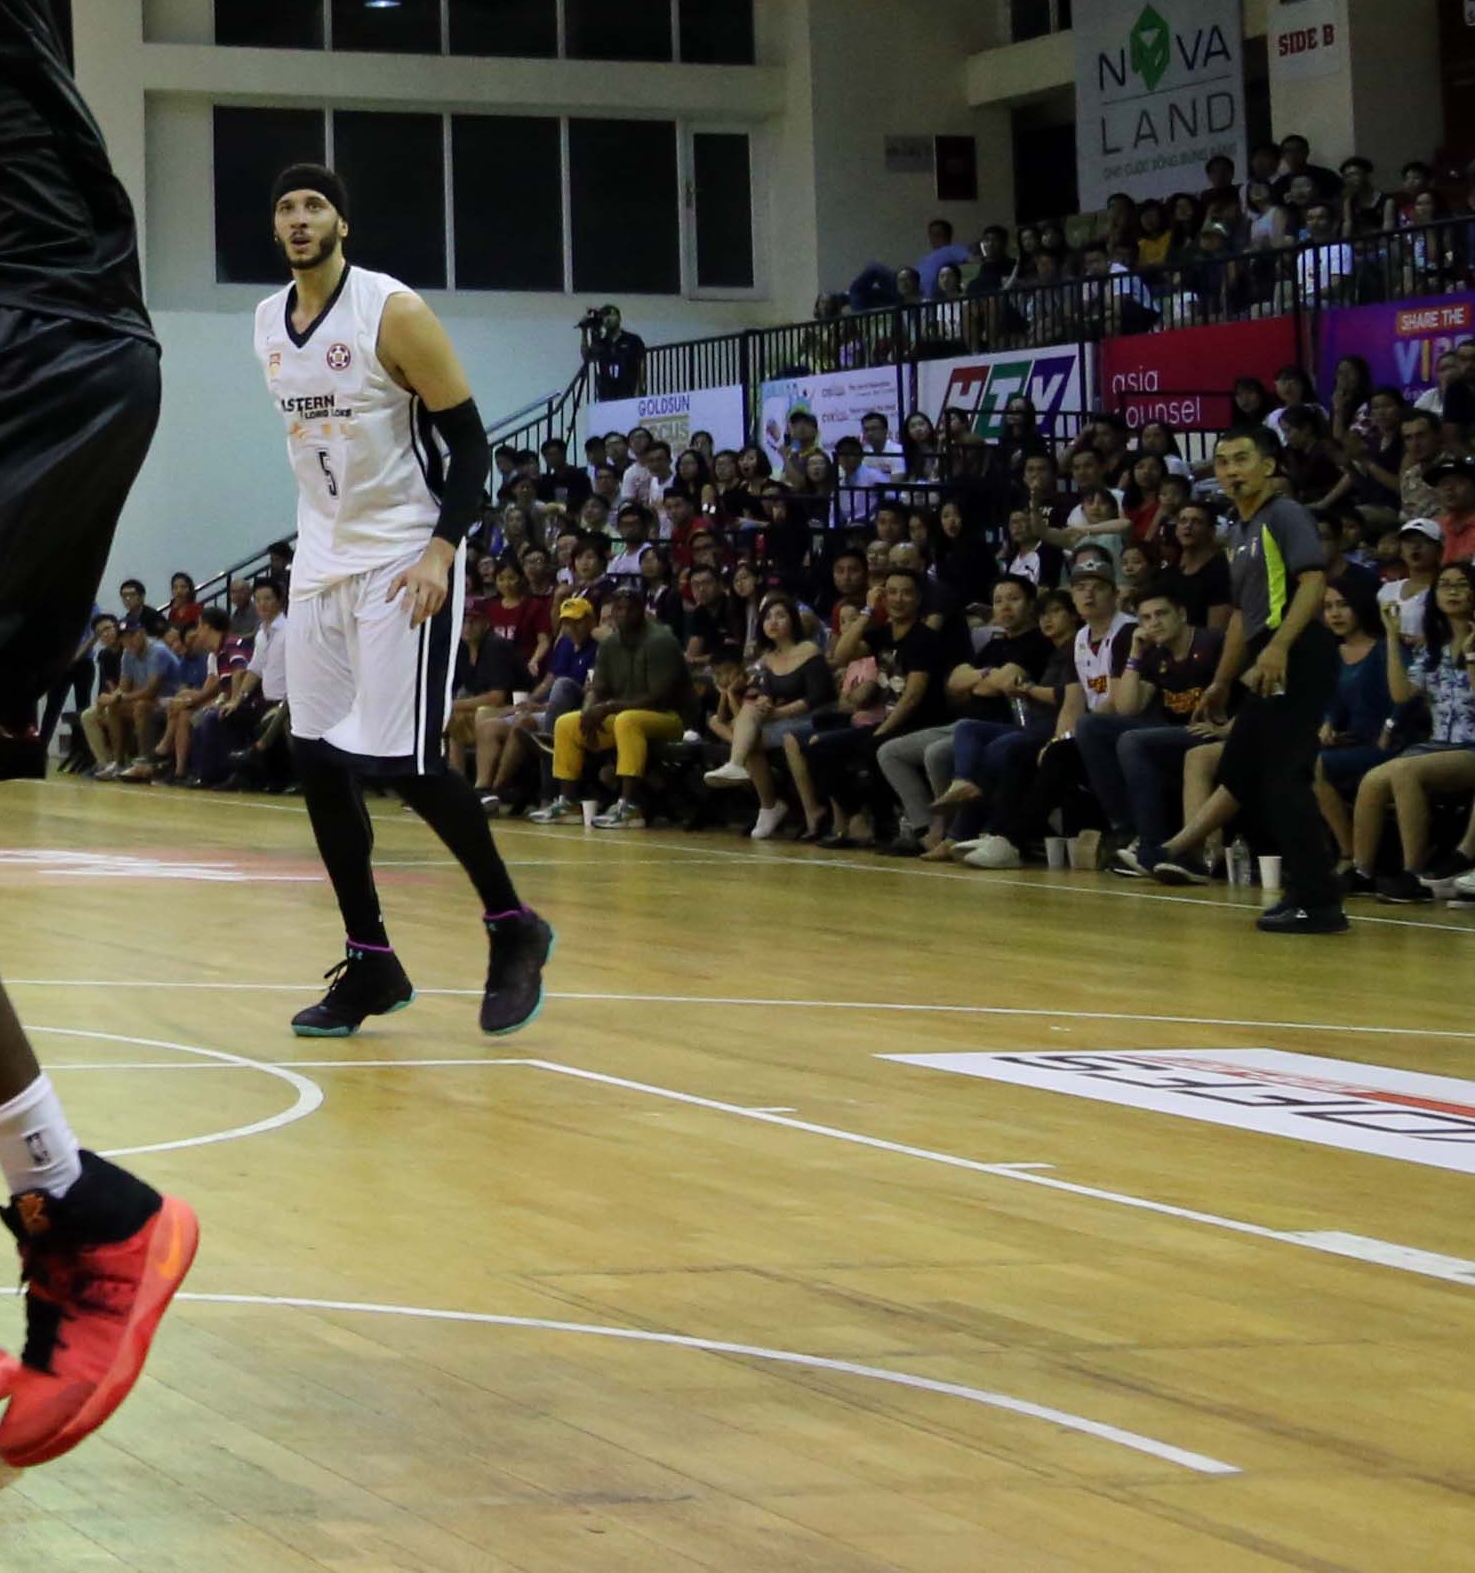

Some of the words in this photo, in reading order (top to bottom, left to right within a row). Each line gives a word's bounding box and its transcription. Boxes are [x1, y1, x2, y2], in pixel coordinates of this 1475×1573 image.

[1278, 29, 1318, 57] SIDE
[1322, 23, 1335, 46] B
[1101, 93, 1235, 156] LAND
[1402, 310, 1439, 330] SHARE
[1441, 307, 1464, 326] THE
[1112, 365, 1158, 394] asia
[638, 395, 690, 417] GOLDSUN
[1113, 396, 1201, 429] ounsel
[316, 448, 338, 498] 5
